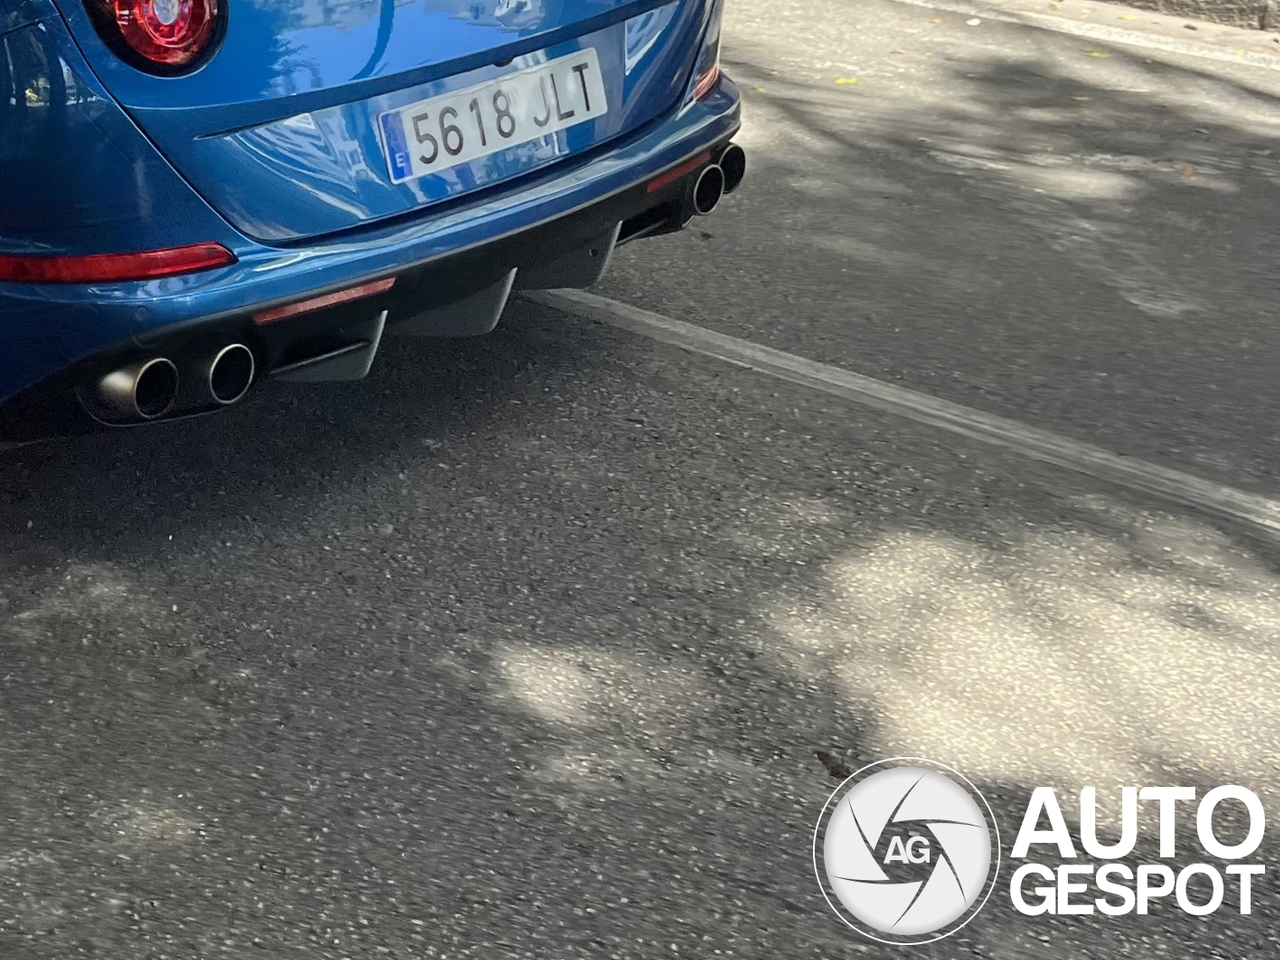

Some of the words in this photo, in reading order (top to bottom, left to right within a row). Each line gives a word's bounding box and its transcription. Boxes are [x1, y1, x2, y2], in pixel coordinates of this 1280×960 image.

[411, 90, 516, 165] 5618
[533, 62, 591, 128] JLT
[395, 152, 406, 168] E
